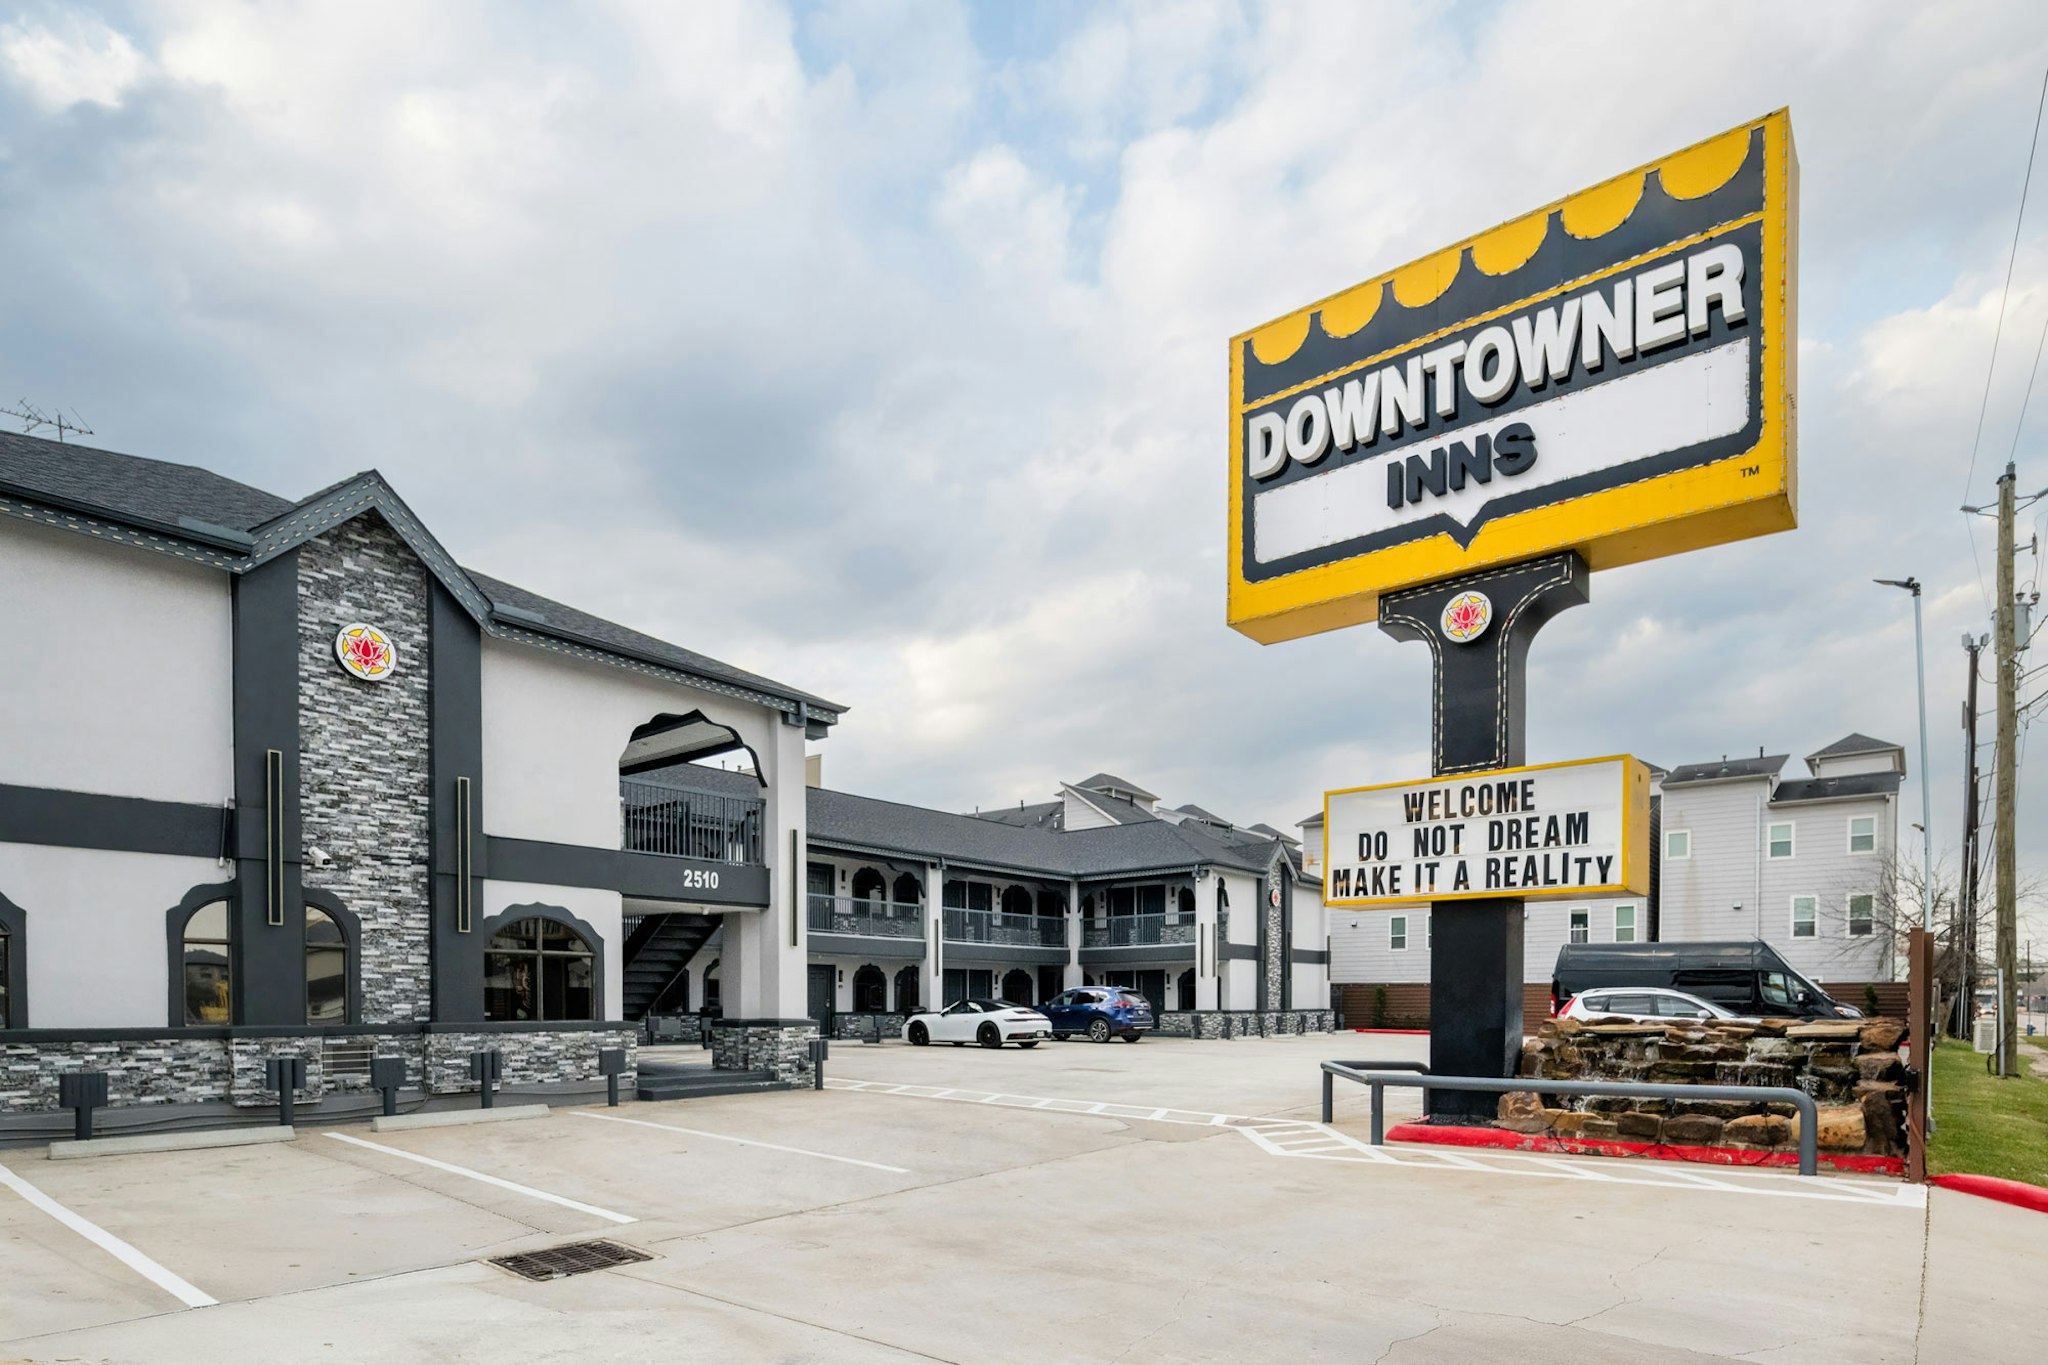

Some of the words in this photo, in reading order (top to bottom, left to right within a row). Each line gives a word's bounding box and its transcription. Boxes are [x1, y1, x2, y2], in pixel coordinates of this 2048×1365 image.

[1249, 243, 1746, 480] DOWNTOWNER
[1387, 422, 1537, 509] INNS
[1740, 464, 1759, 478] TM
[1403, 779, 1535, 823] WELCOME
[1358, 831, 1388, 861] DO
[1413, 823, 1465, 857] NOT
[1488, 811, 1589, 851] DREAM
[683, 869, 719, 889] 2510
[1332, 864, 1402, 898] MAKE
[1415, 862, 1440, 893] IT
[1453, 860, 1469, 891] A
[1485, 852, 1613, 886] REALITY
